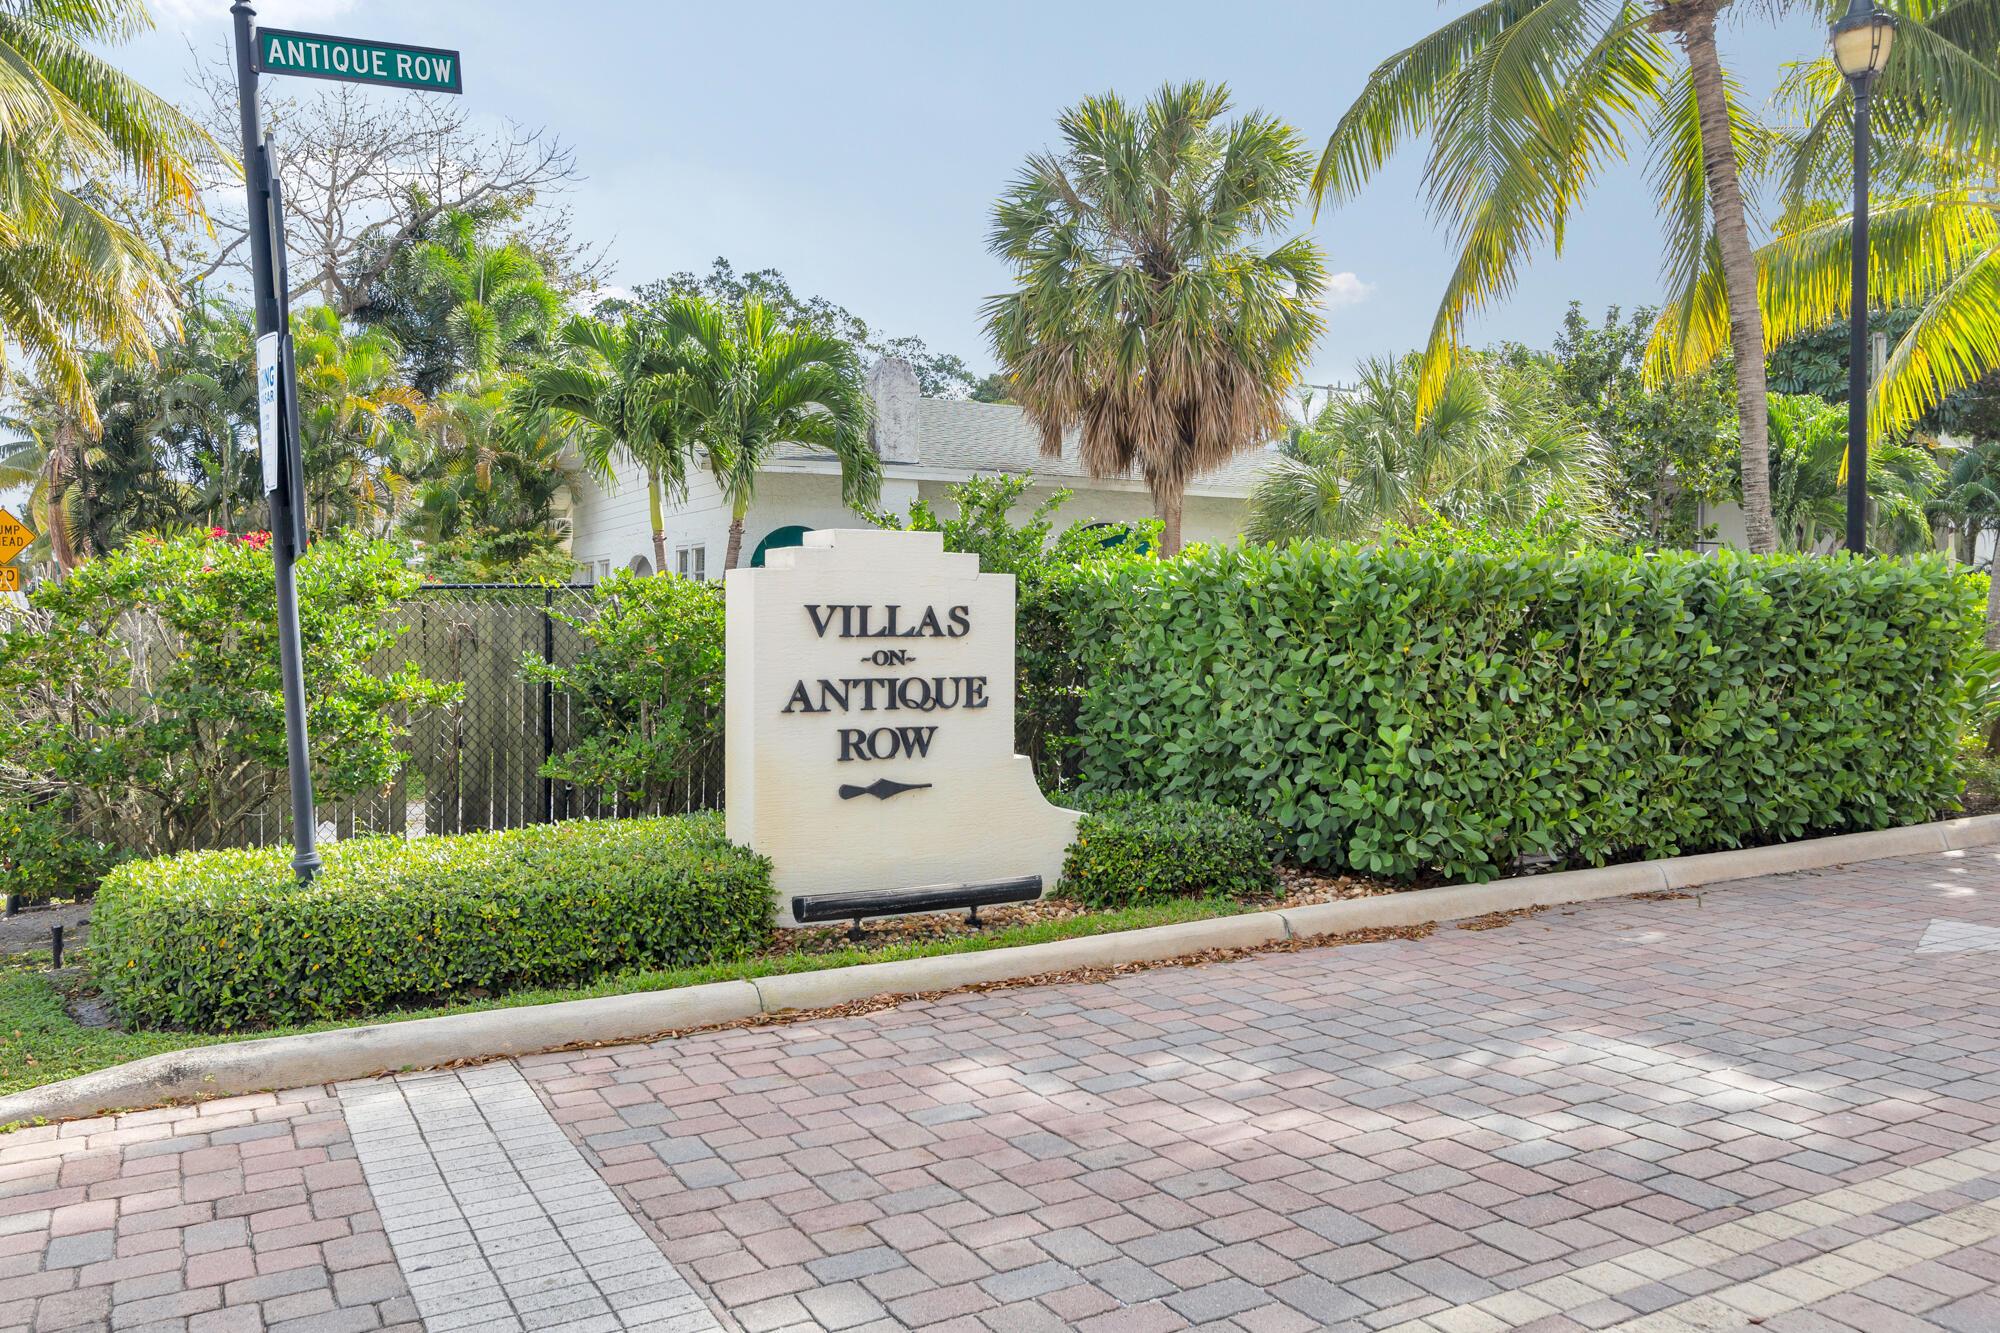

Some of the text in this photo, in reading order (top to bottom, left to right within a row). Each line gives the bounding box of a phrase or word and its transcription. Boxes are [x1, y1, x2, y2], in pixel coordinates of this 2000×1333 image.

[268, 38, 451, 83] ANTIQUE ROW
[0, 525, 20, 535] UMP
[0, 536, 24, 547] EAD
[804, 604, 970, 638] VILLAS
[781, 676, 989, 713] ANTIQUE
[837, 726, 938, 761] ROW
